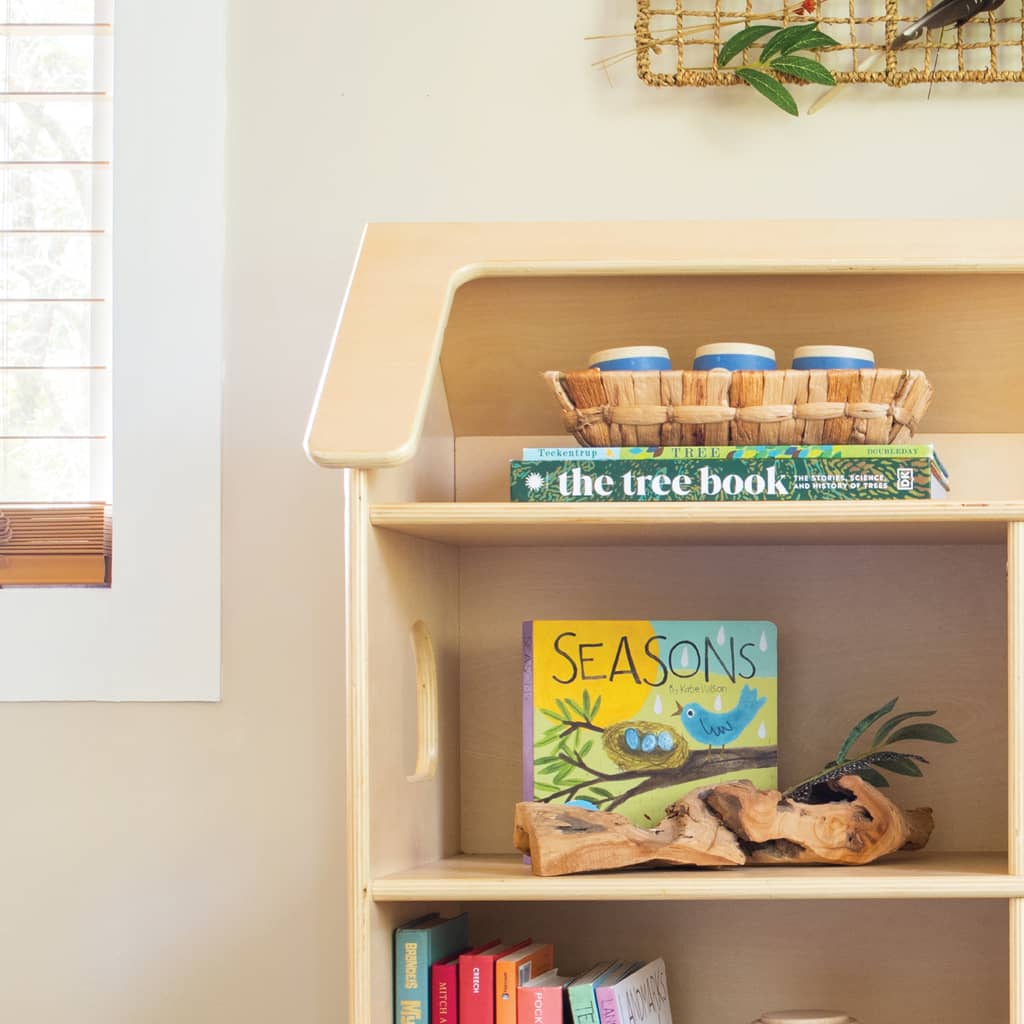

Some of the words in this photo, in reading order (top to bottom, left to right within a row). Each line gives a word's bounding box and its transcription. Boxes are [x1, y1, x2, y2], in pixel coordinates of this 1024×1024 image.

[539, 448, 597, 458] Teckentrup
[671, 447, 720, 458] TREE
[867, 447, 919, 455] DOUBLEDAY
[558, 467, 614, 496] the
[621, 470, 692, 496] tree
[700, 465, 789, 496] book
[793, 482, 809, 490] AND
[812, 482, 848, 490] HISTORY
[850, 482, 861, 490] OF
[863, 481, 888, 489] TREES
[812, 474, 848, 483] STORIES,
[551, 632, 756, 687] SEASONS
[404, 942, 418, 989] BRANDEIS
[472, 967, 480, 994] CREECH
[439, 982, 448, 1014] MITCH
